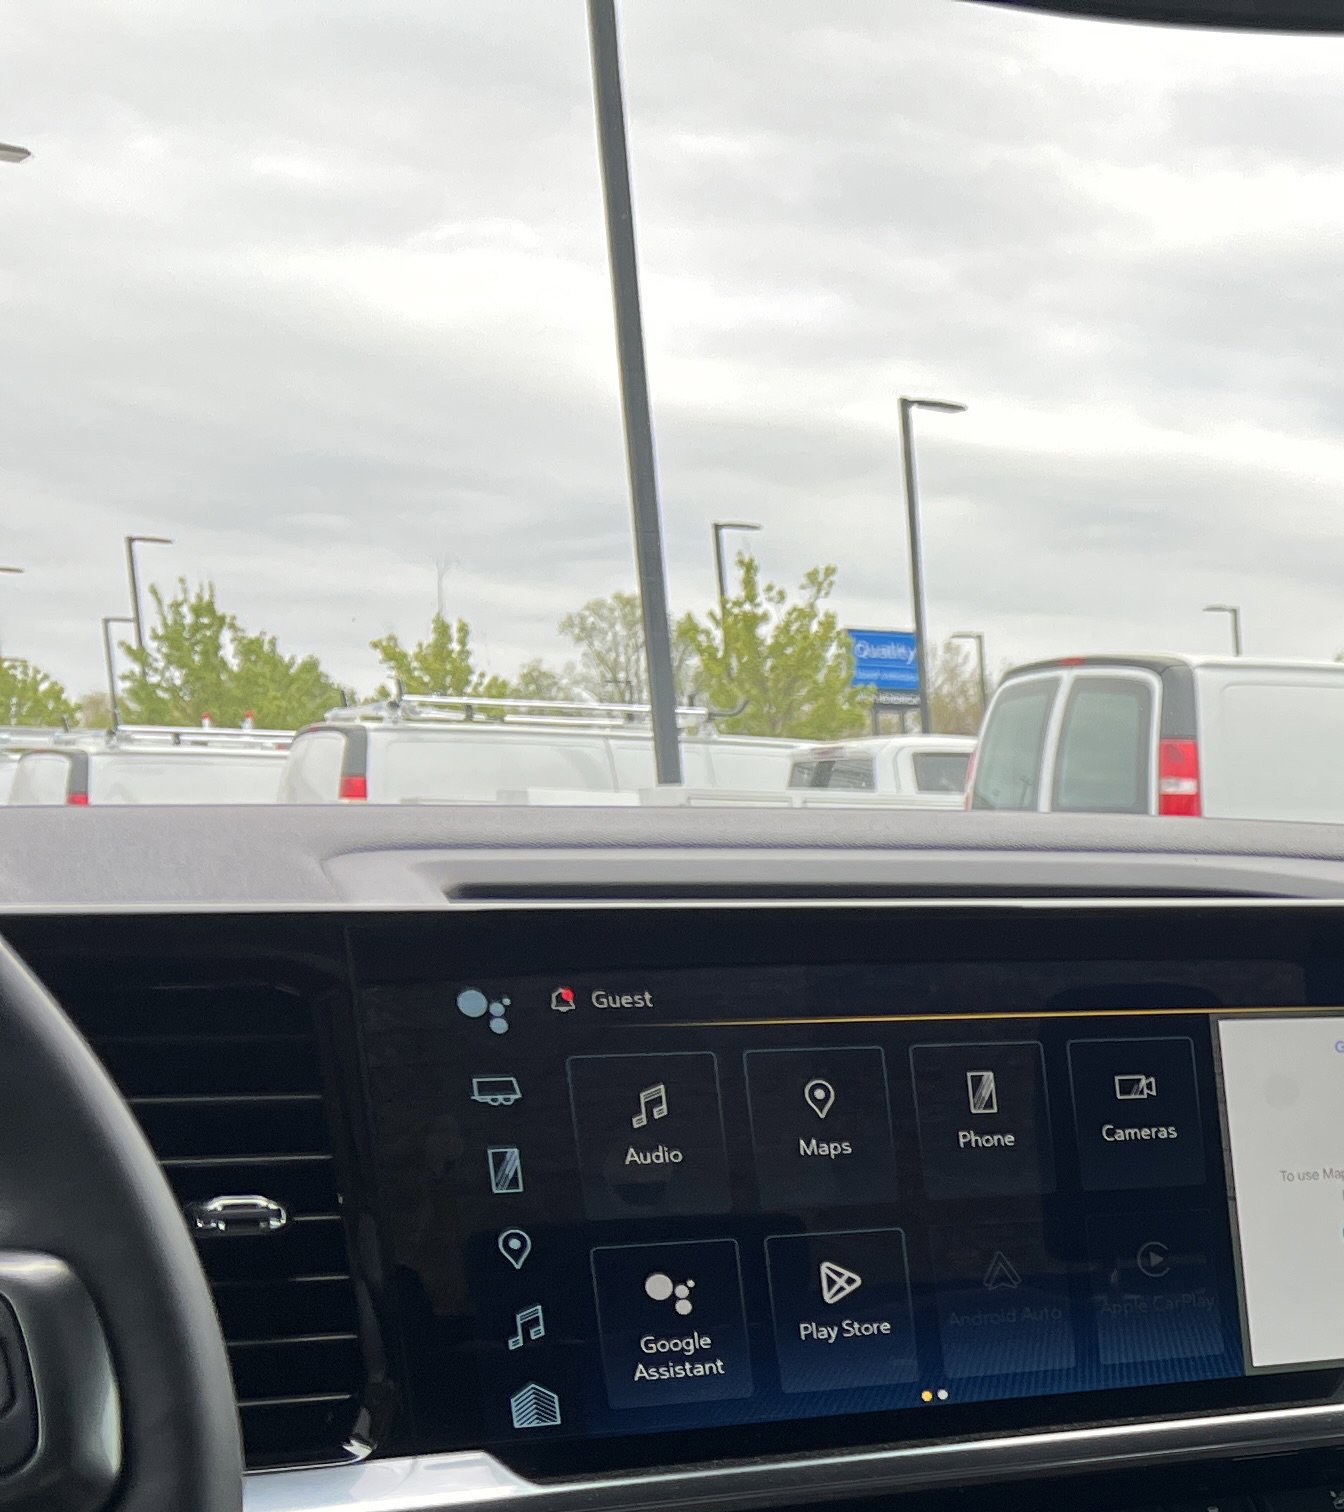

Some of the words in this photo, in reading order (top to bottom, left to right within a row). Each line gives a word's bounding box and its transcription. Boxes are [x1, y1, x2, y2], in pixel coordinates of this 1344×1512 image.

[855, 641, 917, 665] Quality
[591, 989, 654, 1010] Guest
[957, 1129, 1016, 1150] Phone
[1101, 1121, 1178, 1142] Cameras
[624, 1143, 683, 1165] Audio
[800, 1136, 853, 1160] Maps
[1280, 1169, 1296, 1182] To
[1298, 1170, 1320, 1182] use
[951, 1305, 1017, 1327] Android
[1023, 1303, 1063, 1320] Auto
[1101, 1293, 1148, 1315] Apple
[1152, 1292, 1216, 1312] CarPlay
[799, 1320, 840, 1344] Play
[843, 1317, 891, 1338] Store
[639, 1330, 713, 1357] Google
[633, 1357, 725, 1381] Assistant
